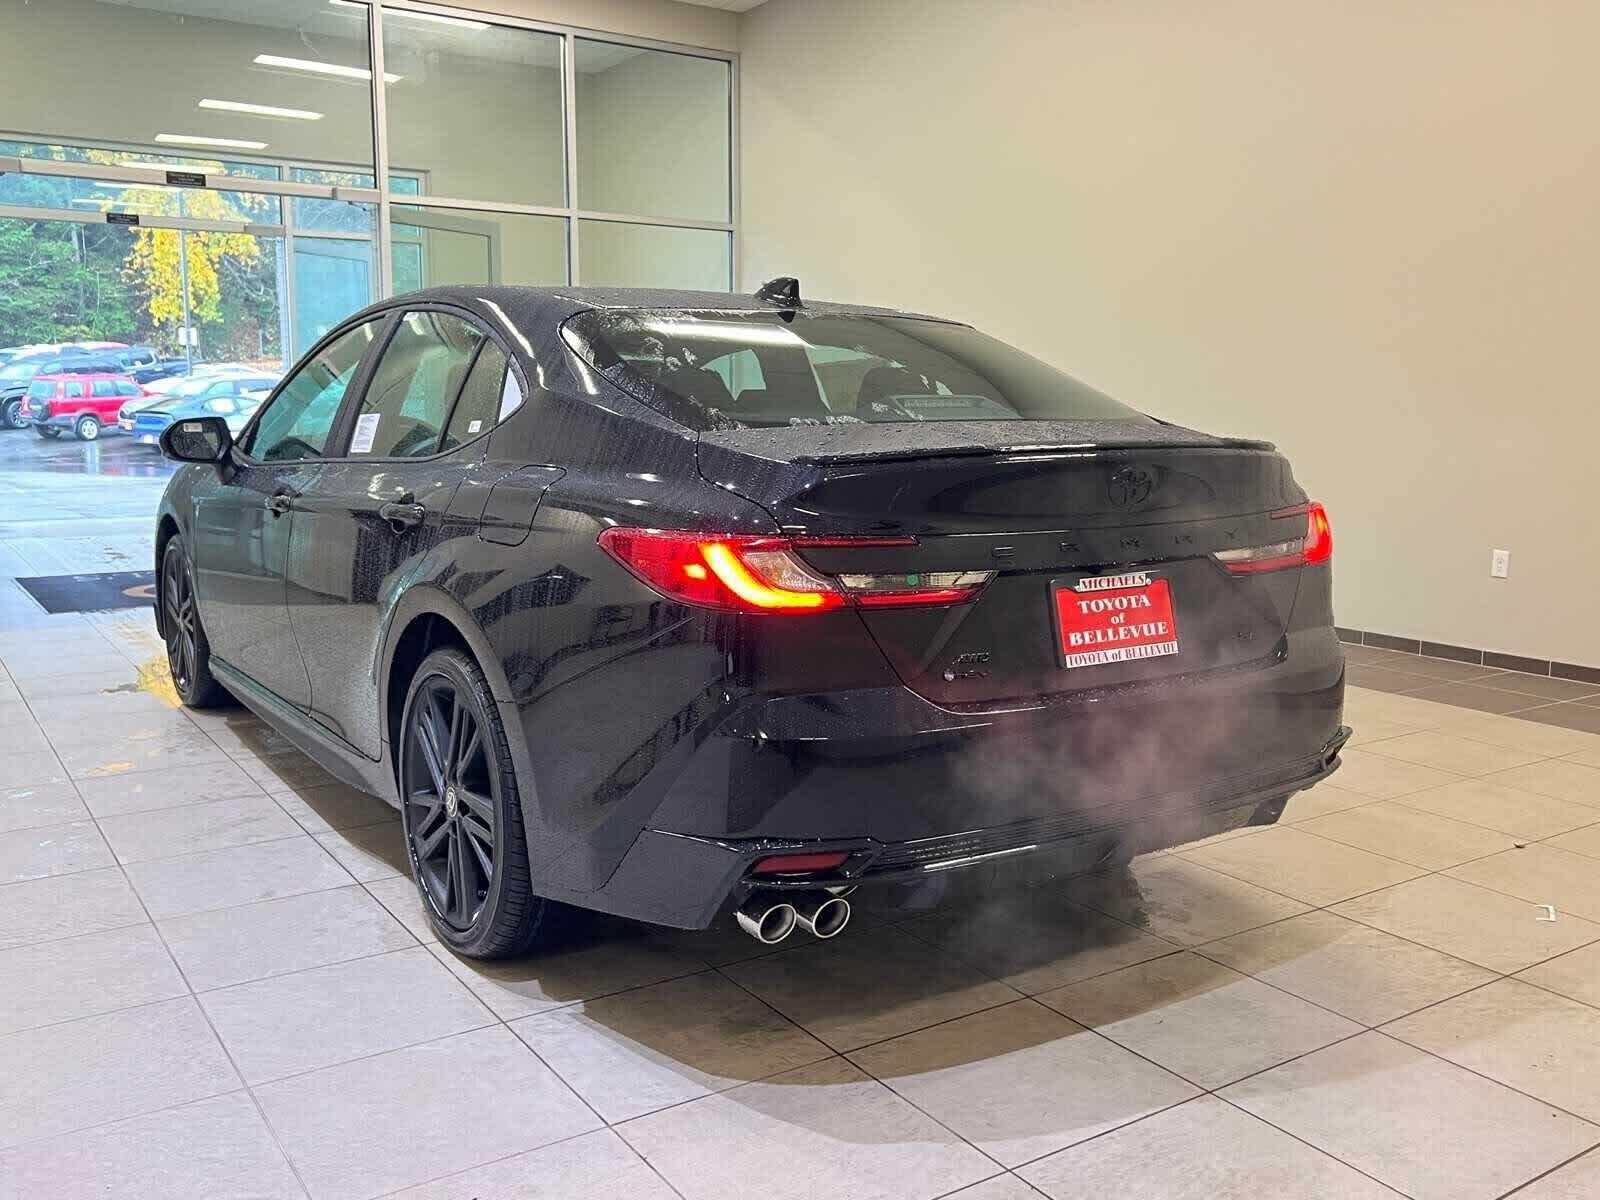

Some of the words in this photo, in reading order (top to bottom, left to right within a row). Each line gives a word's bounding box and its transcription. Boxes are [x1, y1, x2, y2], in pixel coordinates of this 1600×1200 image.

[1081, 575, 1145, 590] MICHAELS
[1077, 594, 1152, 614] TOYOTA
[1110, 612, 1126, 625] of
[1068, 621, 1169, 646] BELLEVUE
[1068, 651, 1110, 667] TOYOTA
[1112, 650, 1122, 662] of
[1125, 642, 1178, 659] BELLEVUE
